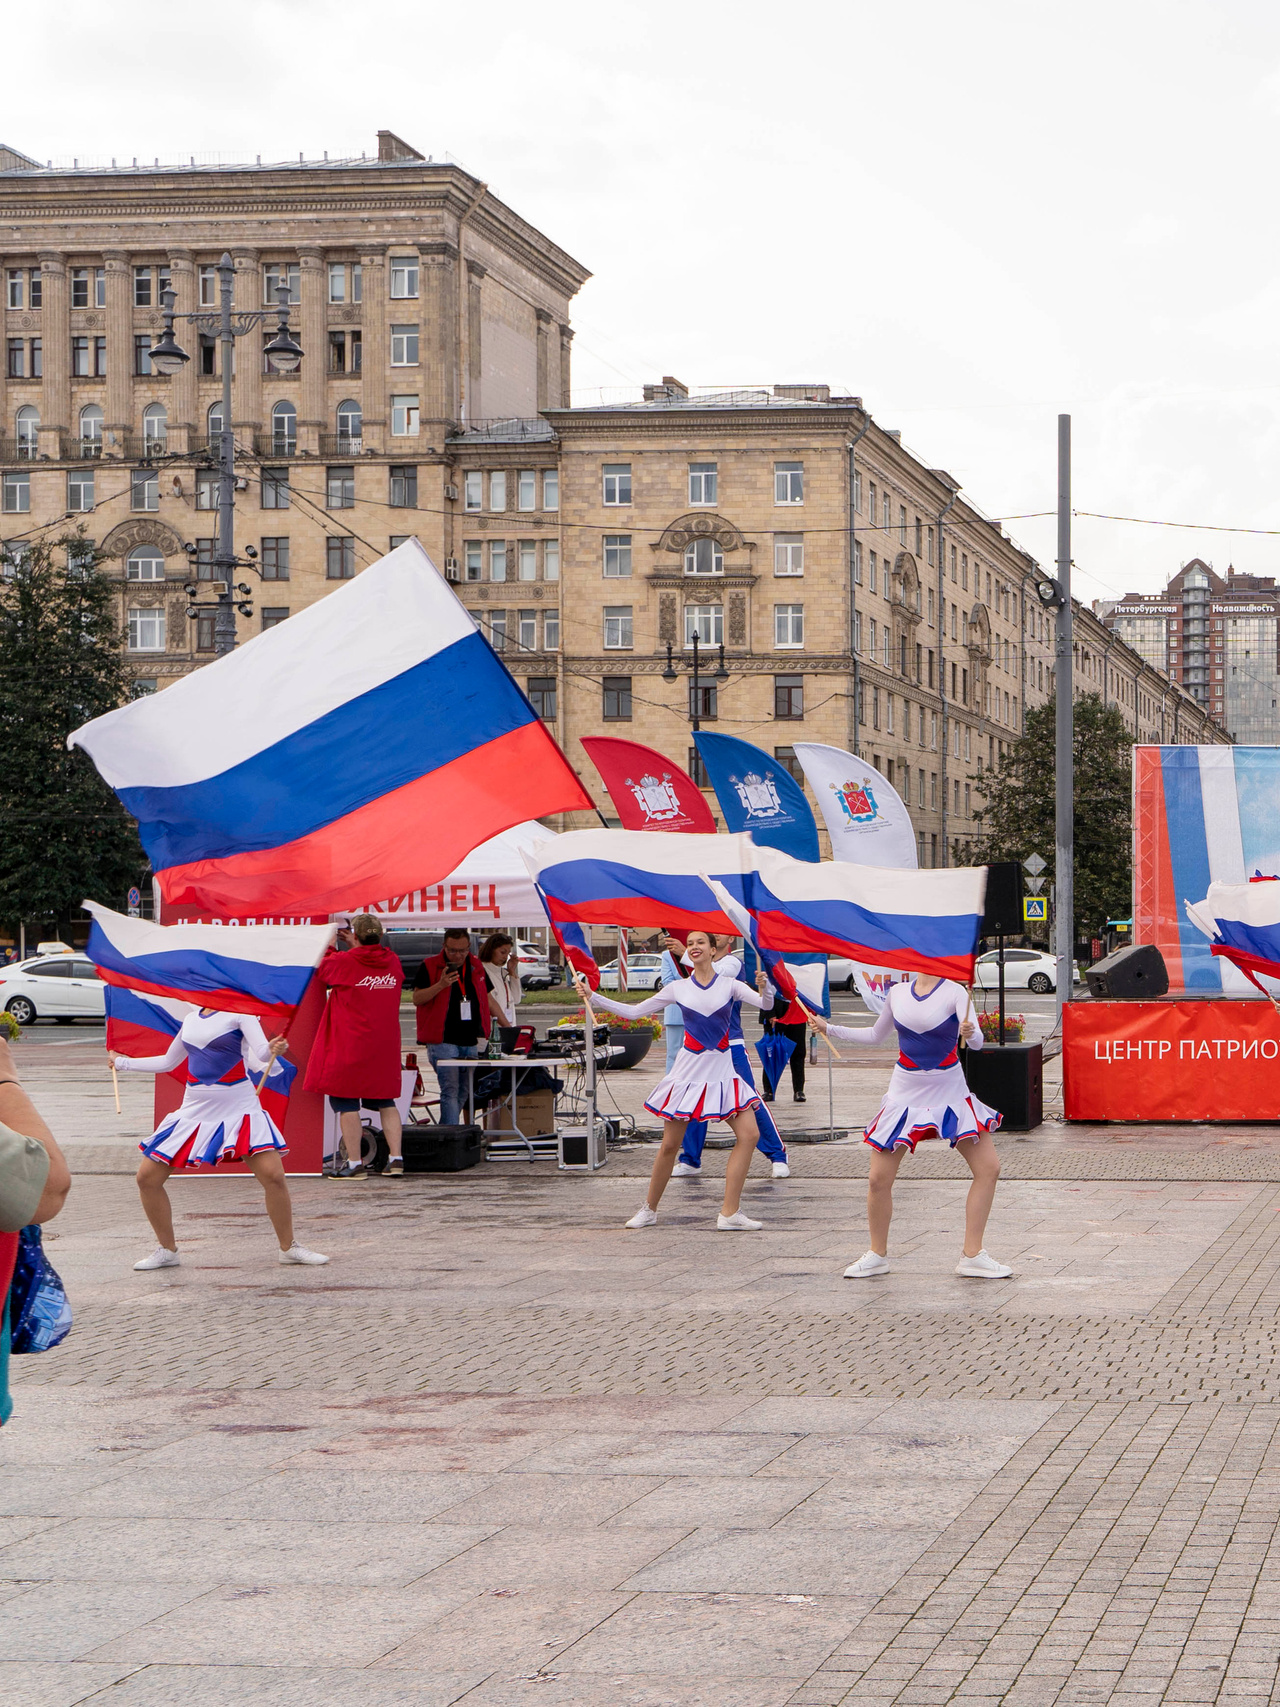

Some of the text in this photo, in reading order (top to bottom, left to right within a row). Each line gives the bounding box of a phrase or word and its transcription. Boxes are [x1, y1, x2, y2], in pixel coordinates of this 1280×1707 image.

[1115, 604, 1275, 614] Петербургская Недвижимость
[1094, 1039, 1172, 1064] ЦЕНТР
